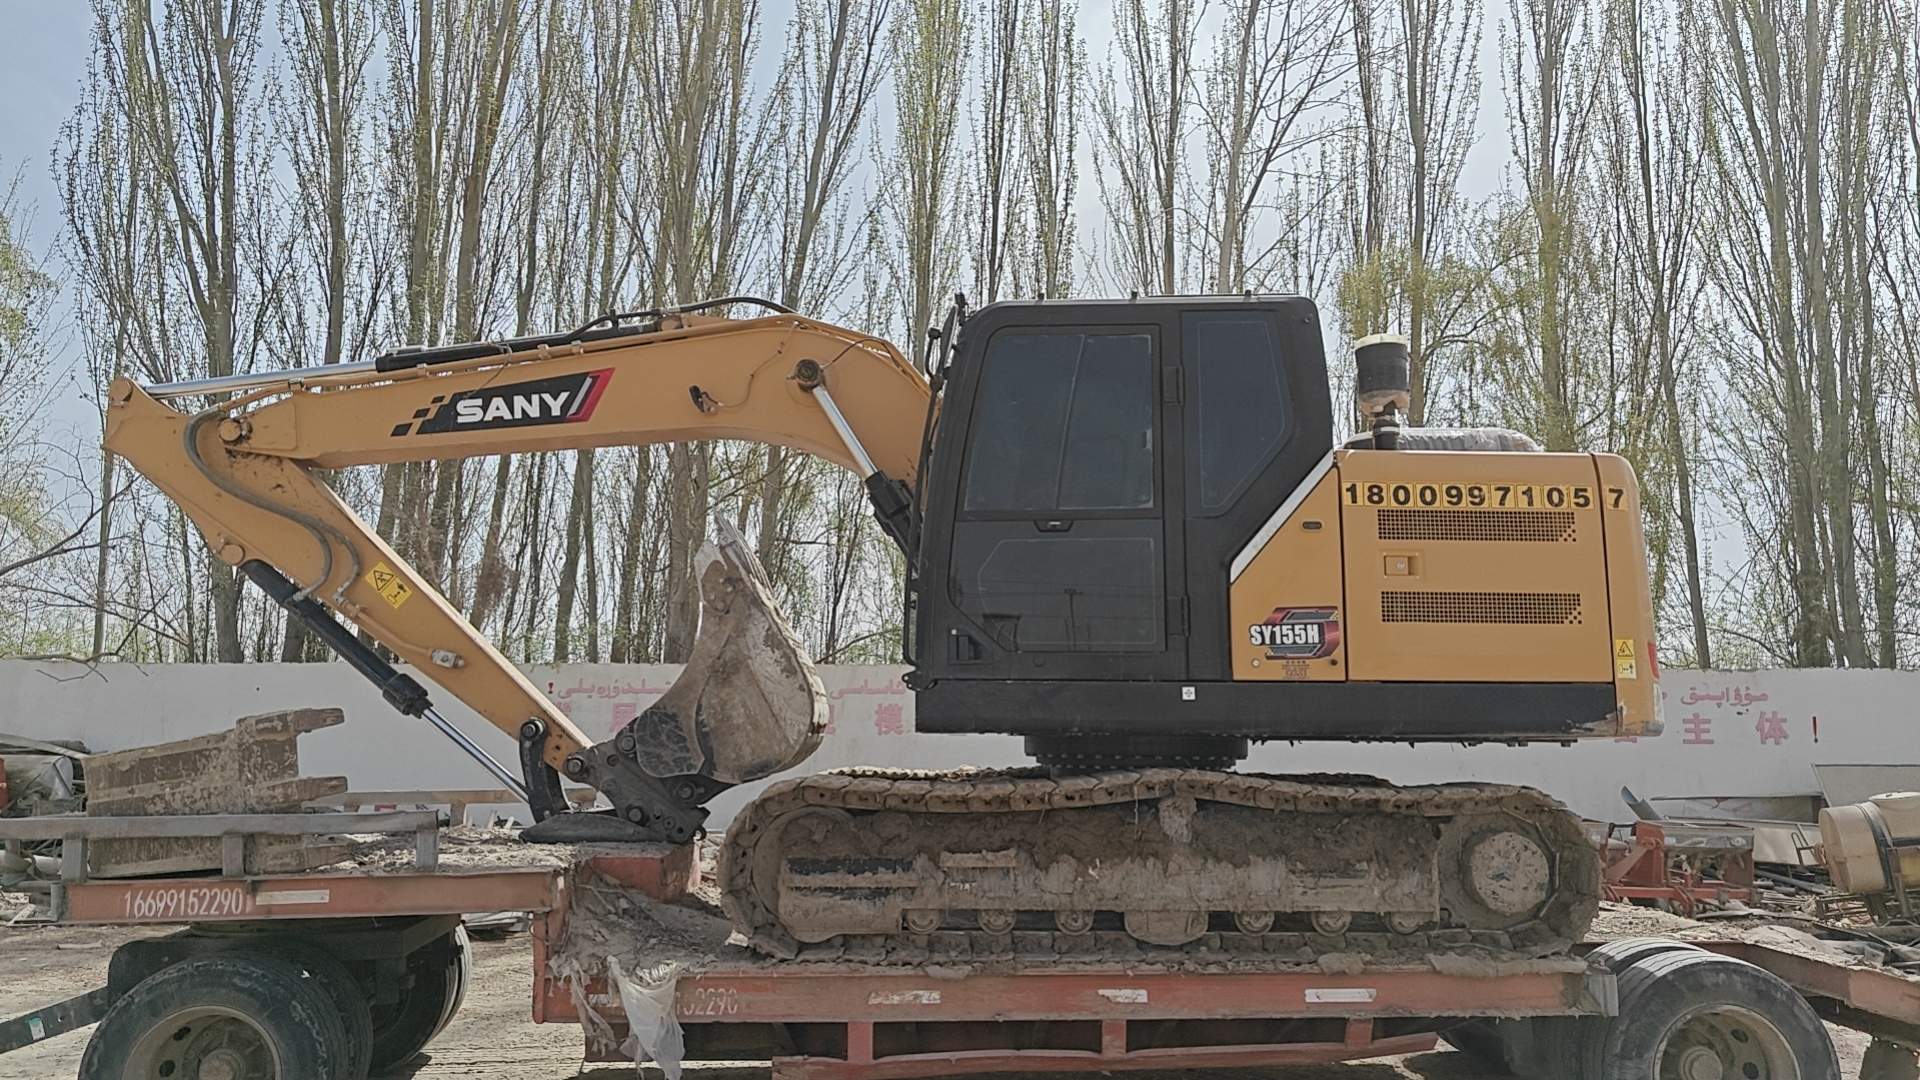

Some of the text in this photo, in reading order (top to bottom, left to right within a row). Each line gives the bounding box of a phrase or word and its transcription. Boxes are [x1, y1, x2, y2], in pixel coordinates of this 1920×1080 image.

[457, 391, 570, 424] SANY
[1249, 623, 1321, 646] SY155H
[124, 887, 243, 919] 16699152290
